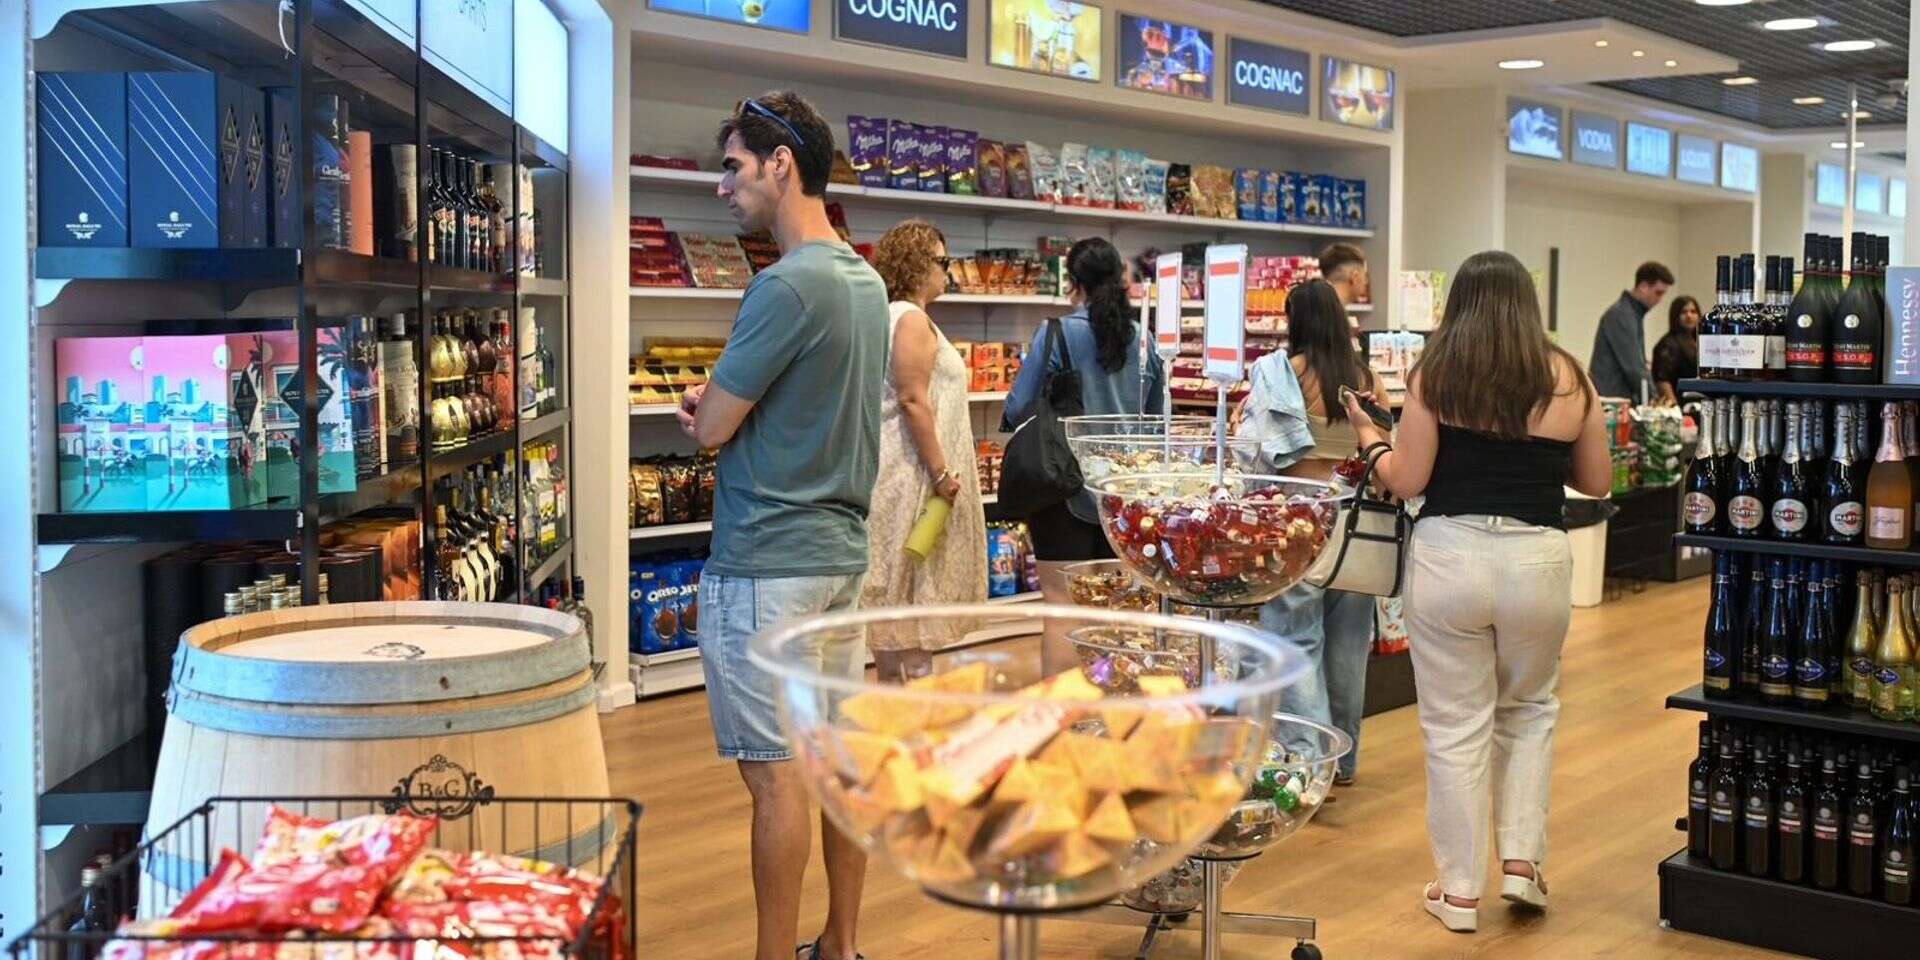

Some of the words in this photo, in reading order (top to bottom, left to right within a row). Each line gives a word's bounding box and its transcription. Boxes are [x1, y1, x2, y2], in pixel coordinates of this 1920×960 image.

[1235, 60, 1303, 95] COGNAC
[1895, 278, 1914, 375] Hennessy
[647, 586, 679, 602] OREO
